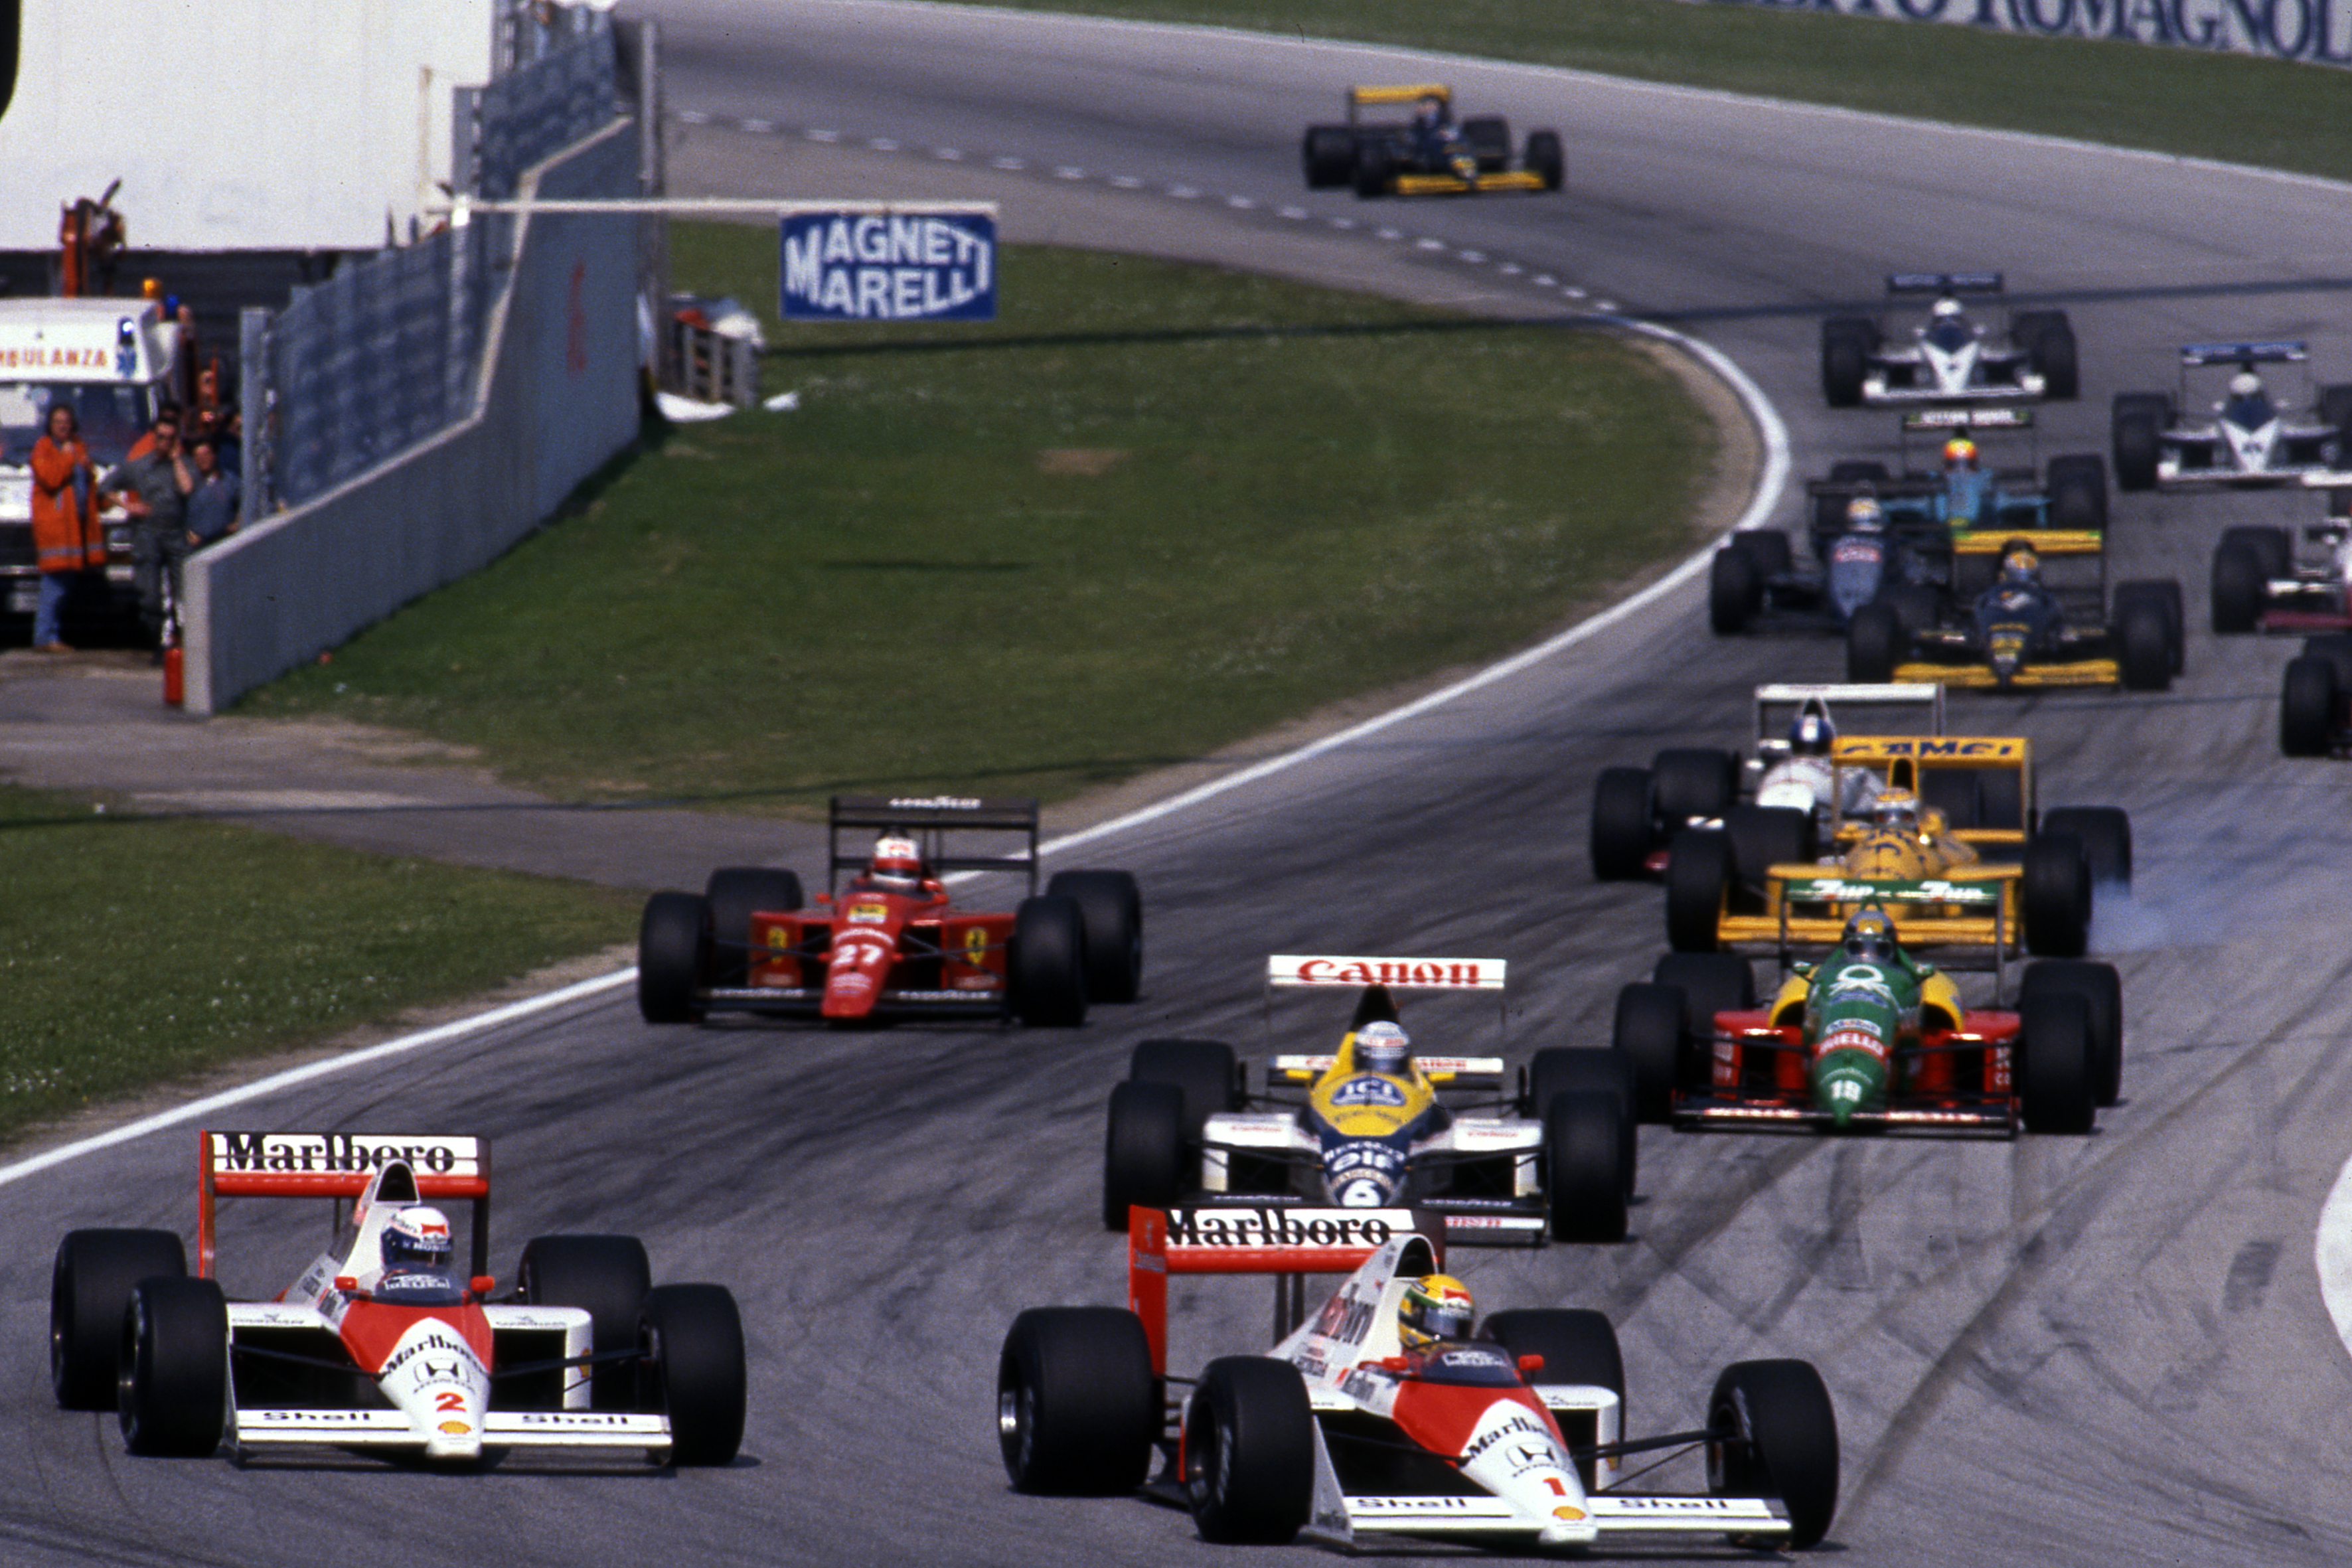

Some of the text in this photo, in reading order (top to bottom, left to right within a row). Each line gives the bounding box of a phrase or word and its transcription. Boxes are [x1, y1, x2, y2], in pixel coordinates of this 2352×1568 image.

[785, 216, 990, 297] MAGNETI
[785, 238, 990, 319] MARELLI
[0, 347, 108, 368] BULANZA
[831, 943, 884, 967] 27
[1296, 959, 1479, 984] Canon
[223, 1133, 455, 1172] Marlboro
[1342, 1179, 1381, 1208] 6
[1166, 1208, 1390, 1246] Marlboro
[435, 1392, 467, 1412] 2
[264, 1411, 371, 1421] Shell
[522, 1415, 628, 1425] Shell
[1467, 1417, 1557, 1459] Marlb
[1543, 1476, 1567, 1496] 1
[1357, 1497, 1466, 1508] Shell
[1620, 1498, 1728, 1509] Shell
